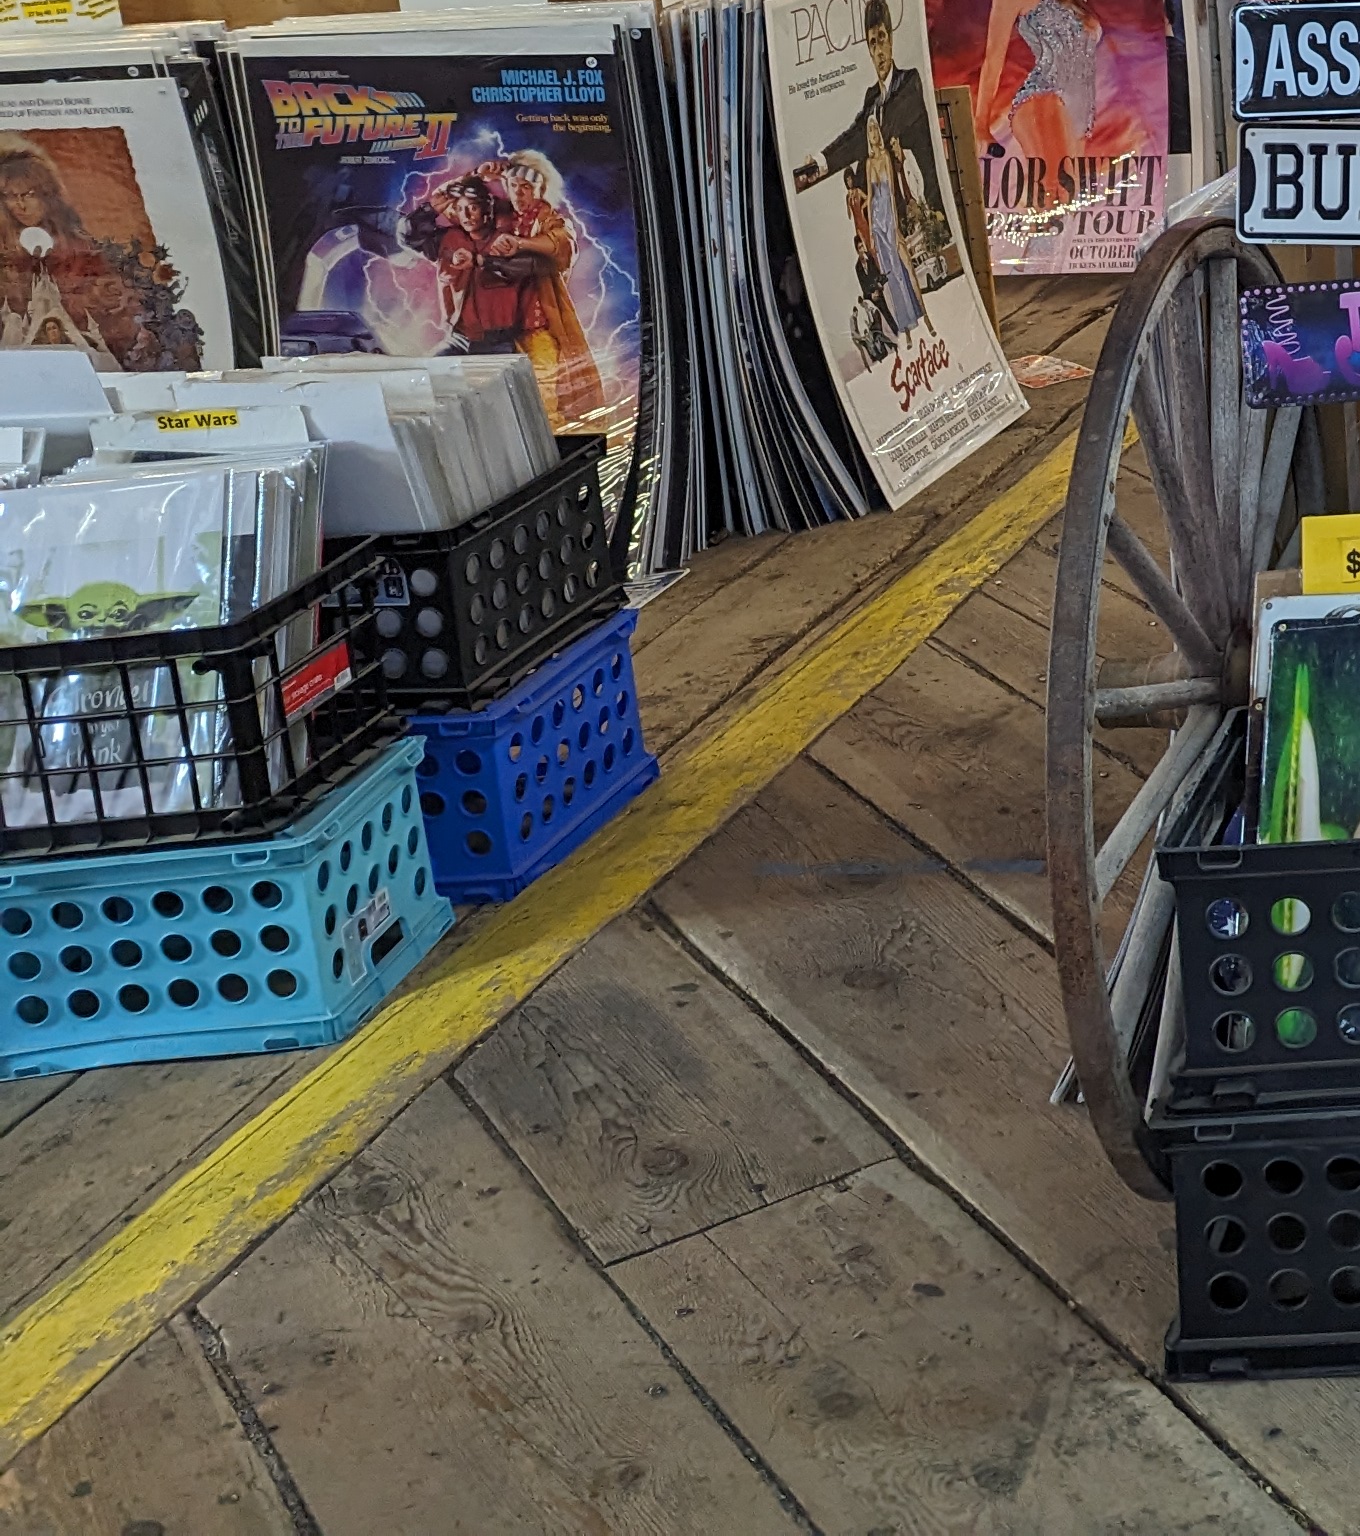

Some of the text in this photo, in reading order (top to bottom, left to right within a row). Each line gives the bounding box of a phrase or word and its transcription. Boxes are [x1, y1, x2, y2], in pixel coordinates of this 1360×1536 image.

[501, 70, 604, 86] MICHAEL J. FOX
[262, 79, 388, 117] BACK
[472, 86, 606, 104] CHRISTOPHER LLOYD
[276, 117, 300, 134] TO
[301, 114, 421, 148] FUTURE
[1058, 155, 1162, 210] SWIFT
[1075, 209, 1157, 236] TOUR
[1070, 244, 1136, 261] OCTOBER
[891, 337, 950, 412] Scarface
[157, 411, 238, 431] Star Wars
